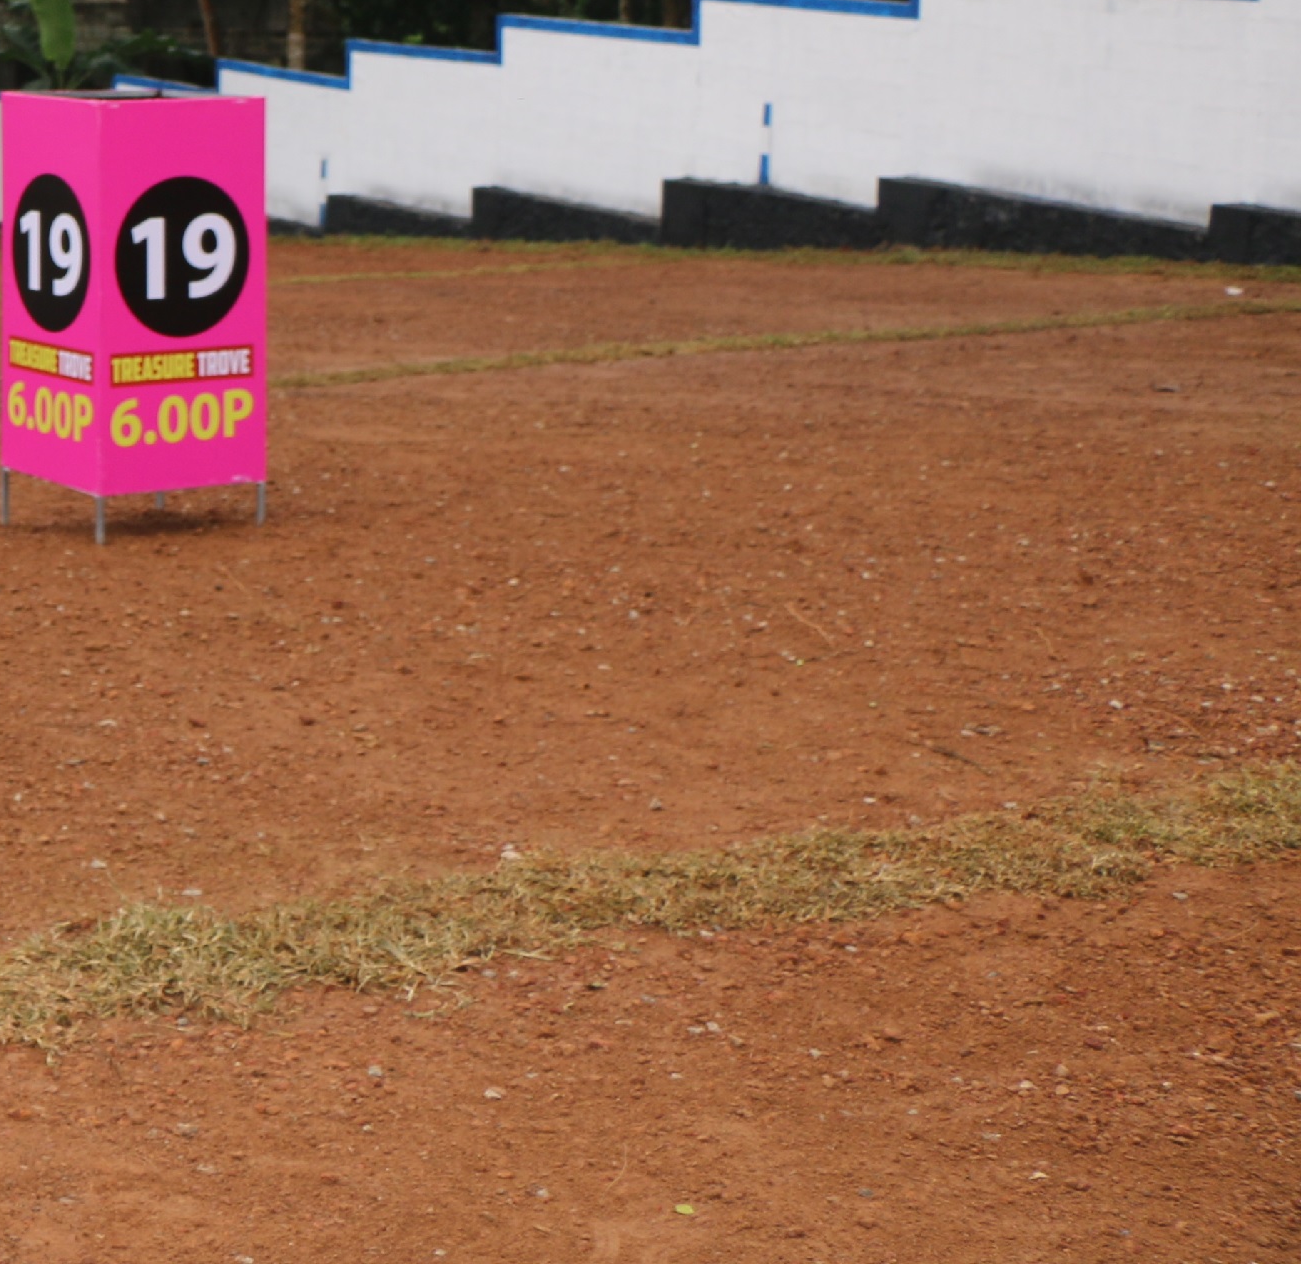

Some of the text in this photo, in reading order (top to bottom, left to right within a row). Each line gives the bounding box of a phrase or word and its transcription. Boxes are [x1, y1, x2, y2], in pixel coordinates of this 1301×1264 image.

[19, 209, 83, 297] 19
[131, 212, 237, 300] 19
[9, 338, 92, 382] TREASURE TROVE
[111, 347, 251, 384] TREASURE TROVE
[8, 381, 93, 442] 6.00P
[110, 388, 254, 447] 6.00P
